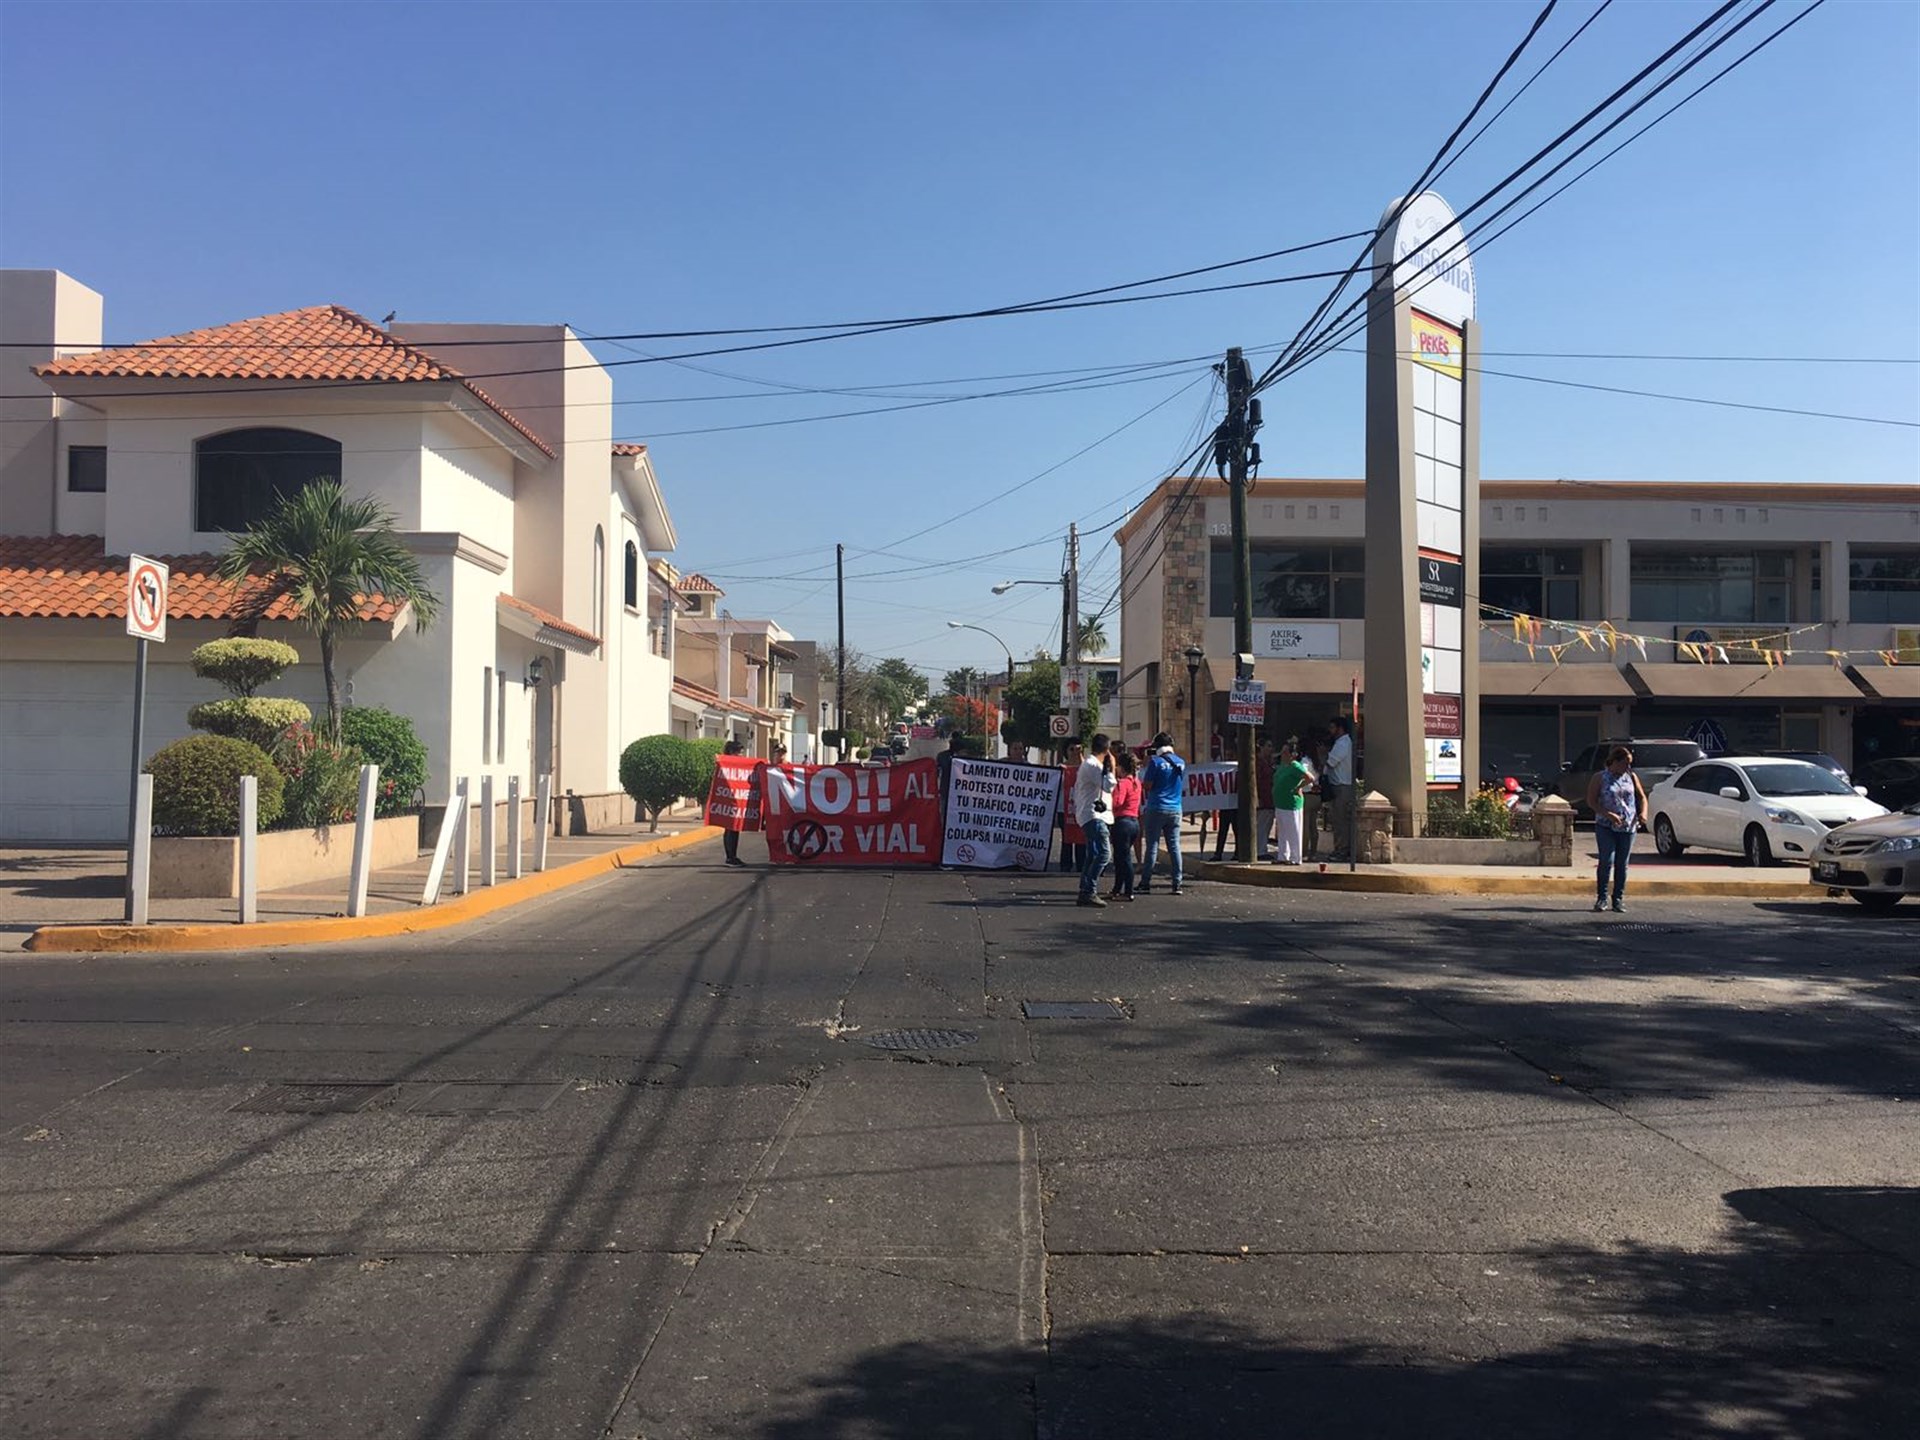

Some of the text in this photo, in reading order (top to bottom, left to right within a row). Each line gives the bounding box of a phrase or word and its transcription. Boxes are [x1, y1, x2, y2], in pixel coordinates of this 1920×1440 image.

[1270, 630, 1298, 638] AKIRE
[1270, 638, 1297, 647] ELISA
[962, 763, 1049, 784] LAMENTO QUE MI
[766, 767, 935, 815] NO!! AL
[954, 779, 1053, 801] PROTESTA COLAPSE
[1188, 773, 1217, 797] PAR
[957, 795, 969, 807] TU
[1020, 803, 1046, 818] PERO
[958, 812, 1040, 834] TU INDIFERENCIA
[854, 823, 926, 853] VIAL
[947, 828, 1047, 851] COLAPSA MI CIUDAD.
